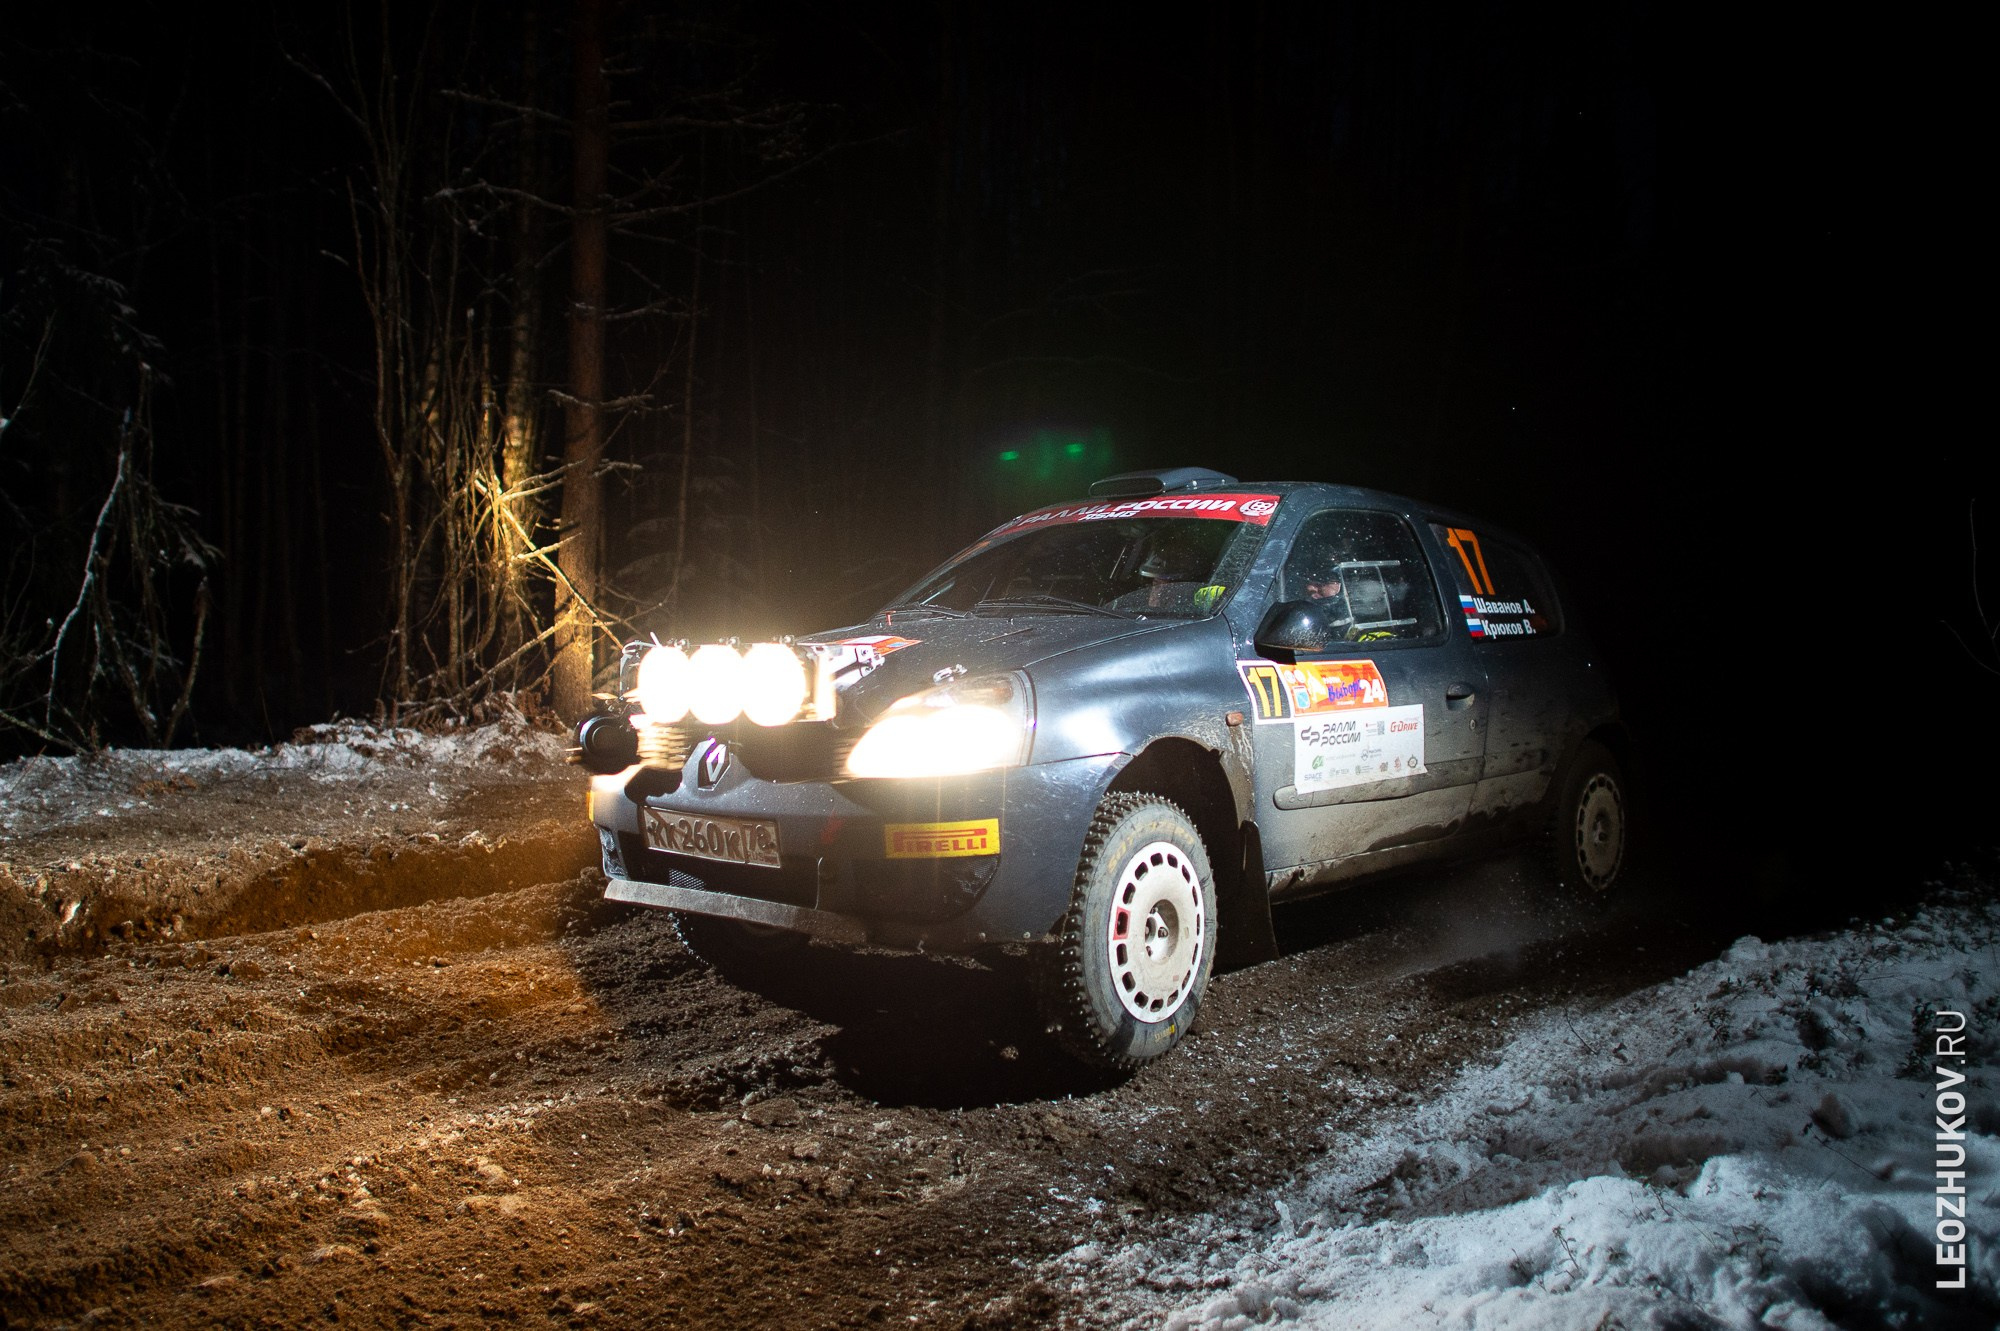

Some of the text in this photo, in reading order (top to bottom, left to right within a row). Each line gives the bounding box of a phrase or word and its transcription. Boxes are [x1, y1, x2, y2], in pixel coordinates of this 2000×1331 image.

[1115, 499, 1238, 512] РОССИИ
[1447, 528, 1496, 595] 17
[1473, 597, 1536, 614] Шаванов А.
[1481, 619, 1536, 639] Крюков В.
[1248, 666, 1282, 718] 17
[1328, 679, 1361, 703] Выбор
[1360, 679, 1385, 703] 24
[1323, 721, 1357, 735] РАЛЛИ
[1321, 732, 1361, 747] РОССИИ
[893, 828, 988, 853] PIRELLI
